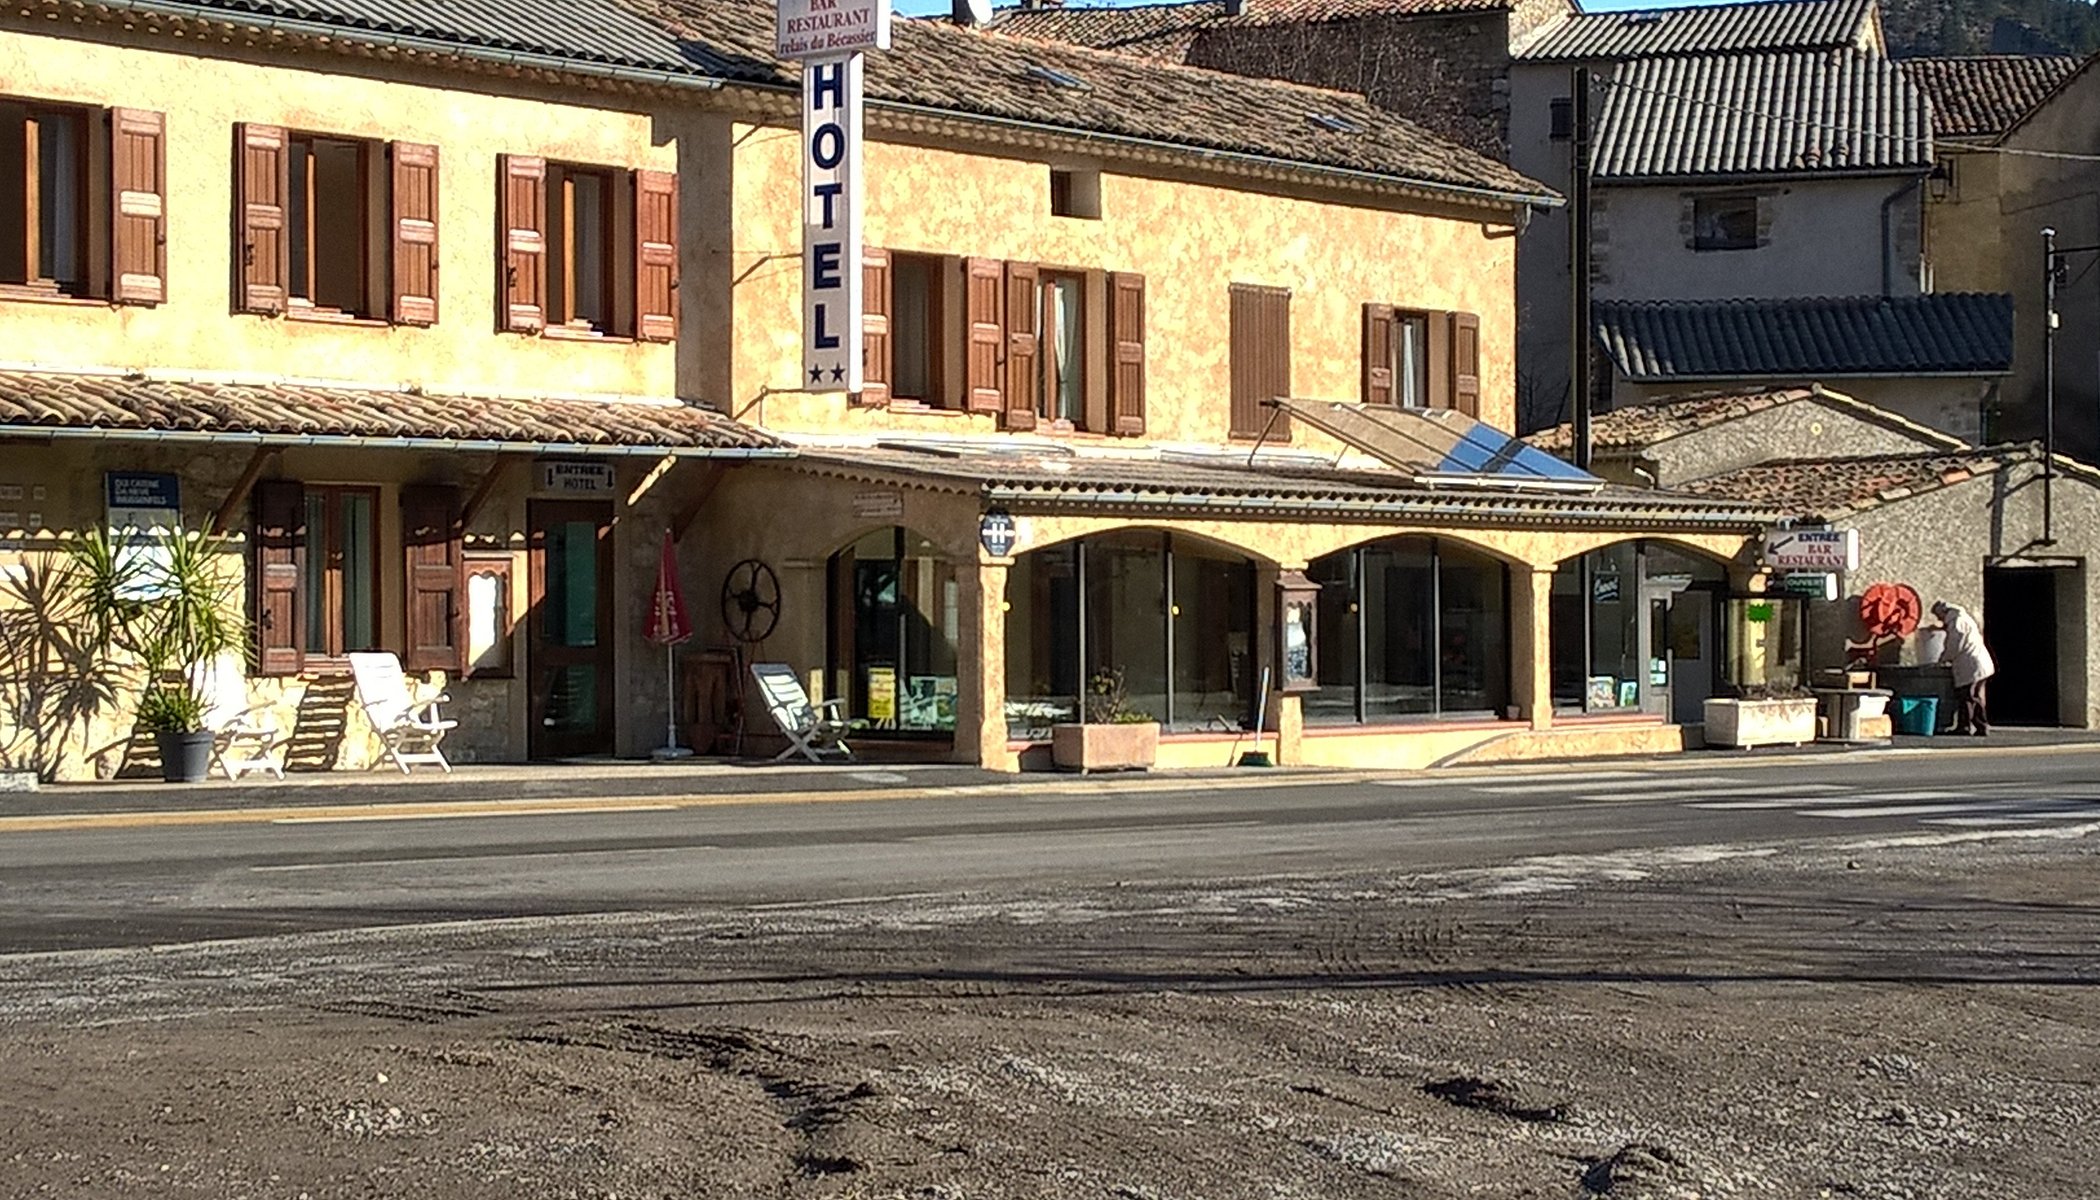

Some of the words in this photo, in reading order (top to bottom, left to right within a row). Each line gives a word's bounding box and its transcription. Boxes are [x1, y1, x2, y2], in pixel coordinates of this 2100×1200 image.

[811, 0, 838, 11] BAR
[787, 8, 870, 34] RESTAURANT
[780, 37, 808, 54] relais
[812, 63, 845, 350] HOTEL
[564, 479, 597, 491] HOTEL
[1808, 544, 1832, 555] BAR
[1778, 555, 1845, 567] RESTAURANT
